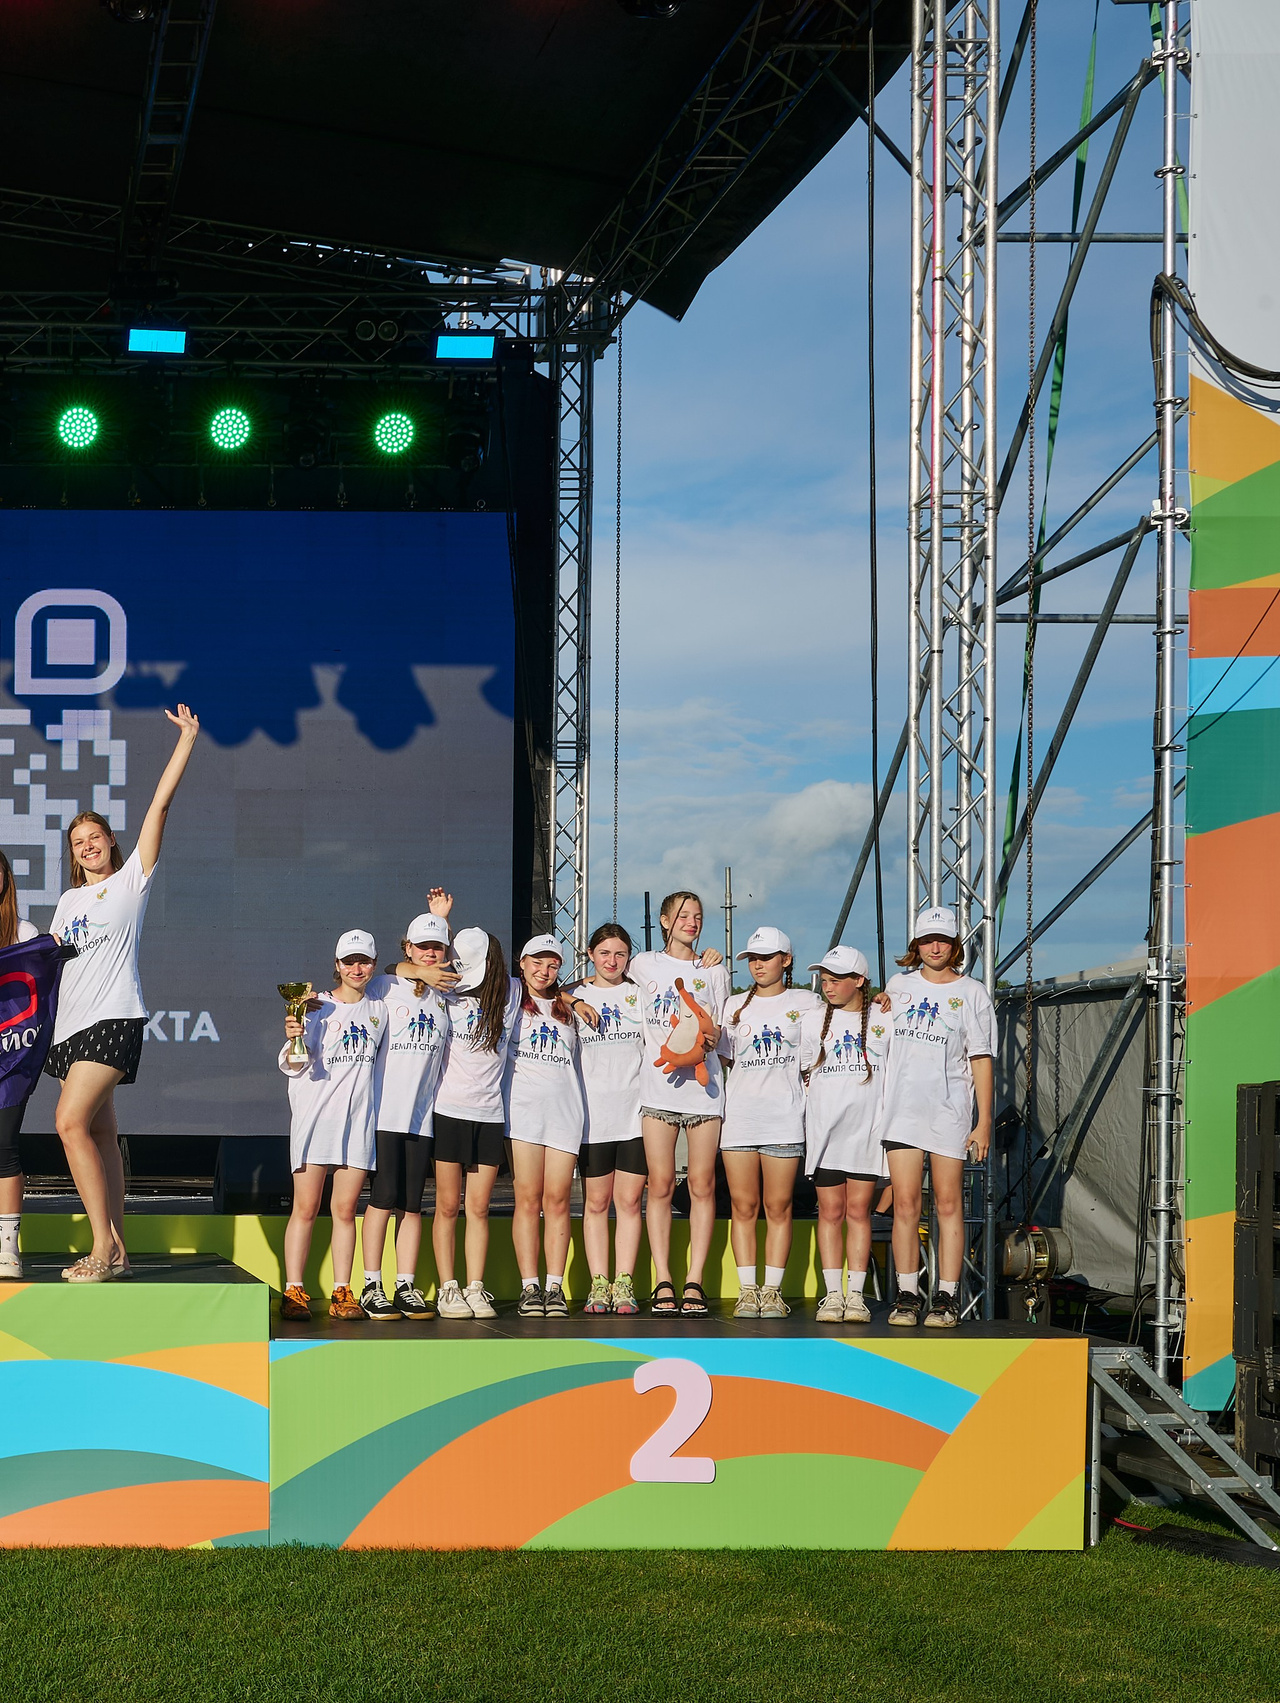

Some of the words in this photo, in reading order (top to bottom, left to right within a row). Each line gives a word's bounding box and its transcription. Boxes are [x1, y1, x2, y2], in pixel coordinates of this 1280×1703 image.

[646, 1017, 661, 1025] ЕМЛЯ
[449, 1029, 474, 1041] ЗЕМЛЯ
[581, 1034, 606, 1044] ЗЕМЛЯ
[608, 1031, 641, 1041] СПОРТА
[894, 1028, 915, 1038] ЕМЛЯ
[390, 1042, 417, 1051] ЗЕМЛЯ
[326, 1054, 353, 1065] ЗЕМЛЯ
[513, 1049, 539, 1060] ЗЕМЛЯ
[541, 1054, 571, 1066] СПОРТА
[740, 1057, 766, 1068] ЗЕМЛЯ
[818, 1064, 846, 1074] ЗЕМЛЯ
[630, 1358, 715, 1483] 2
